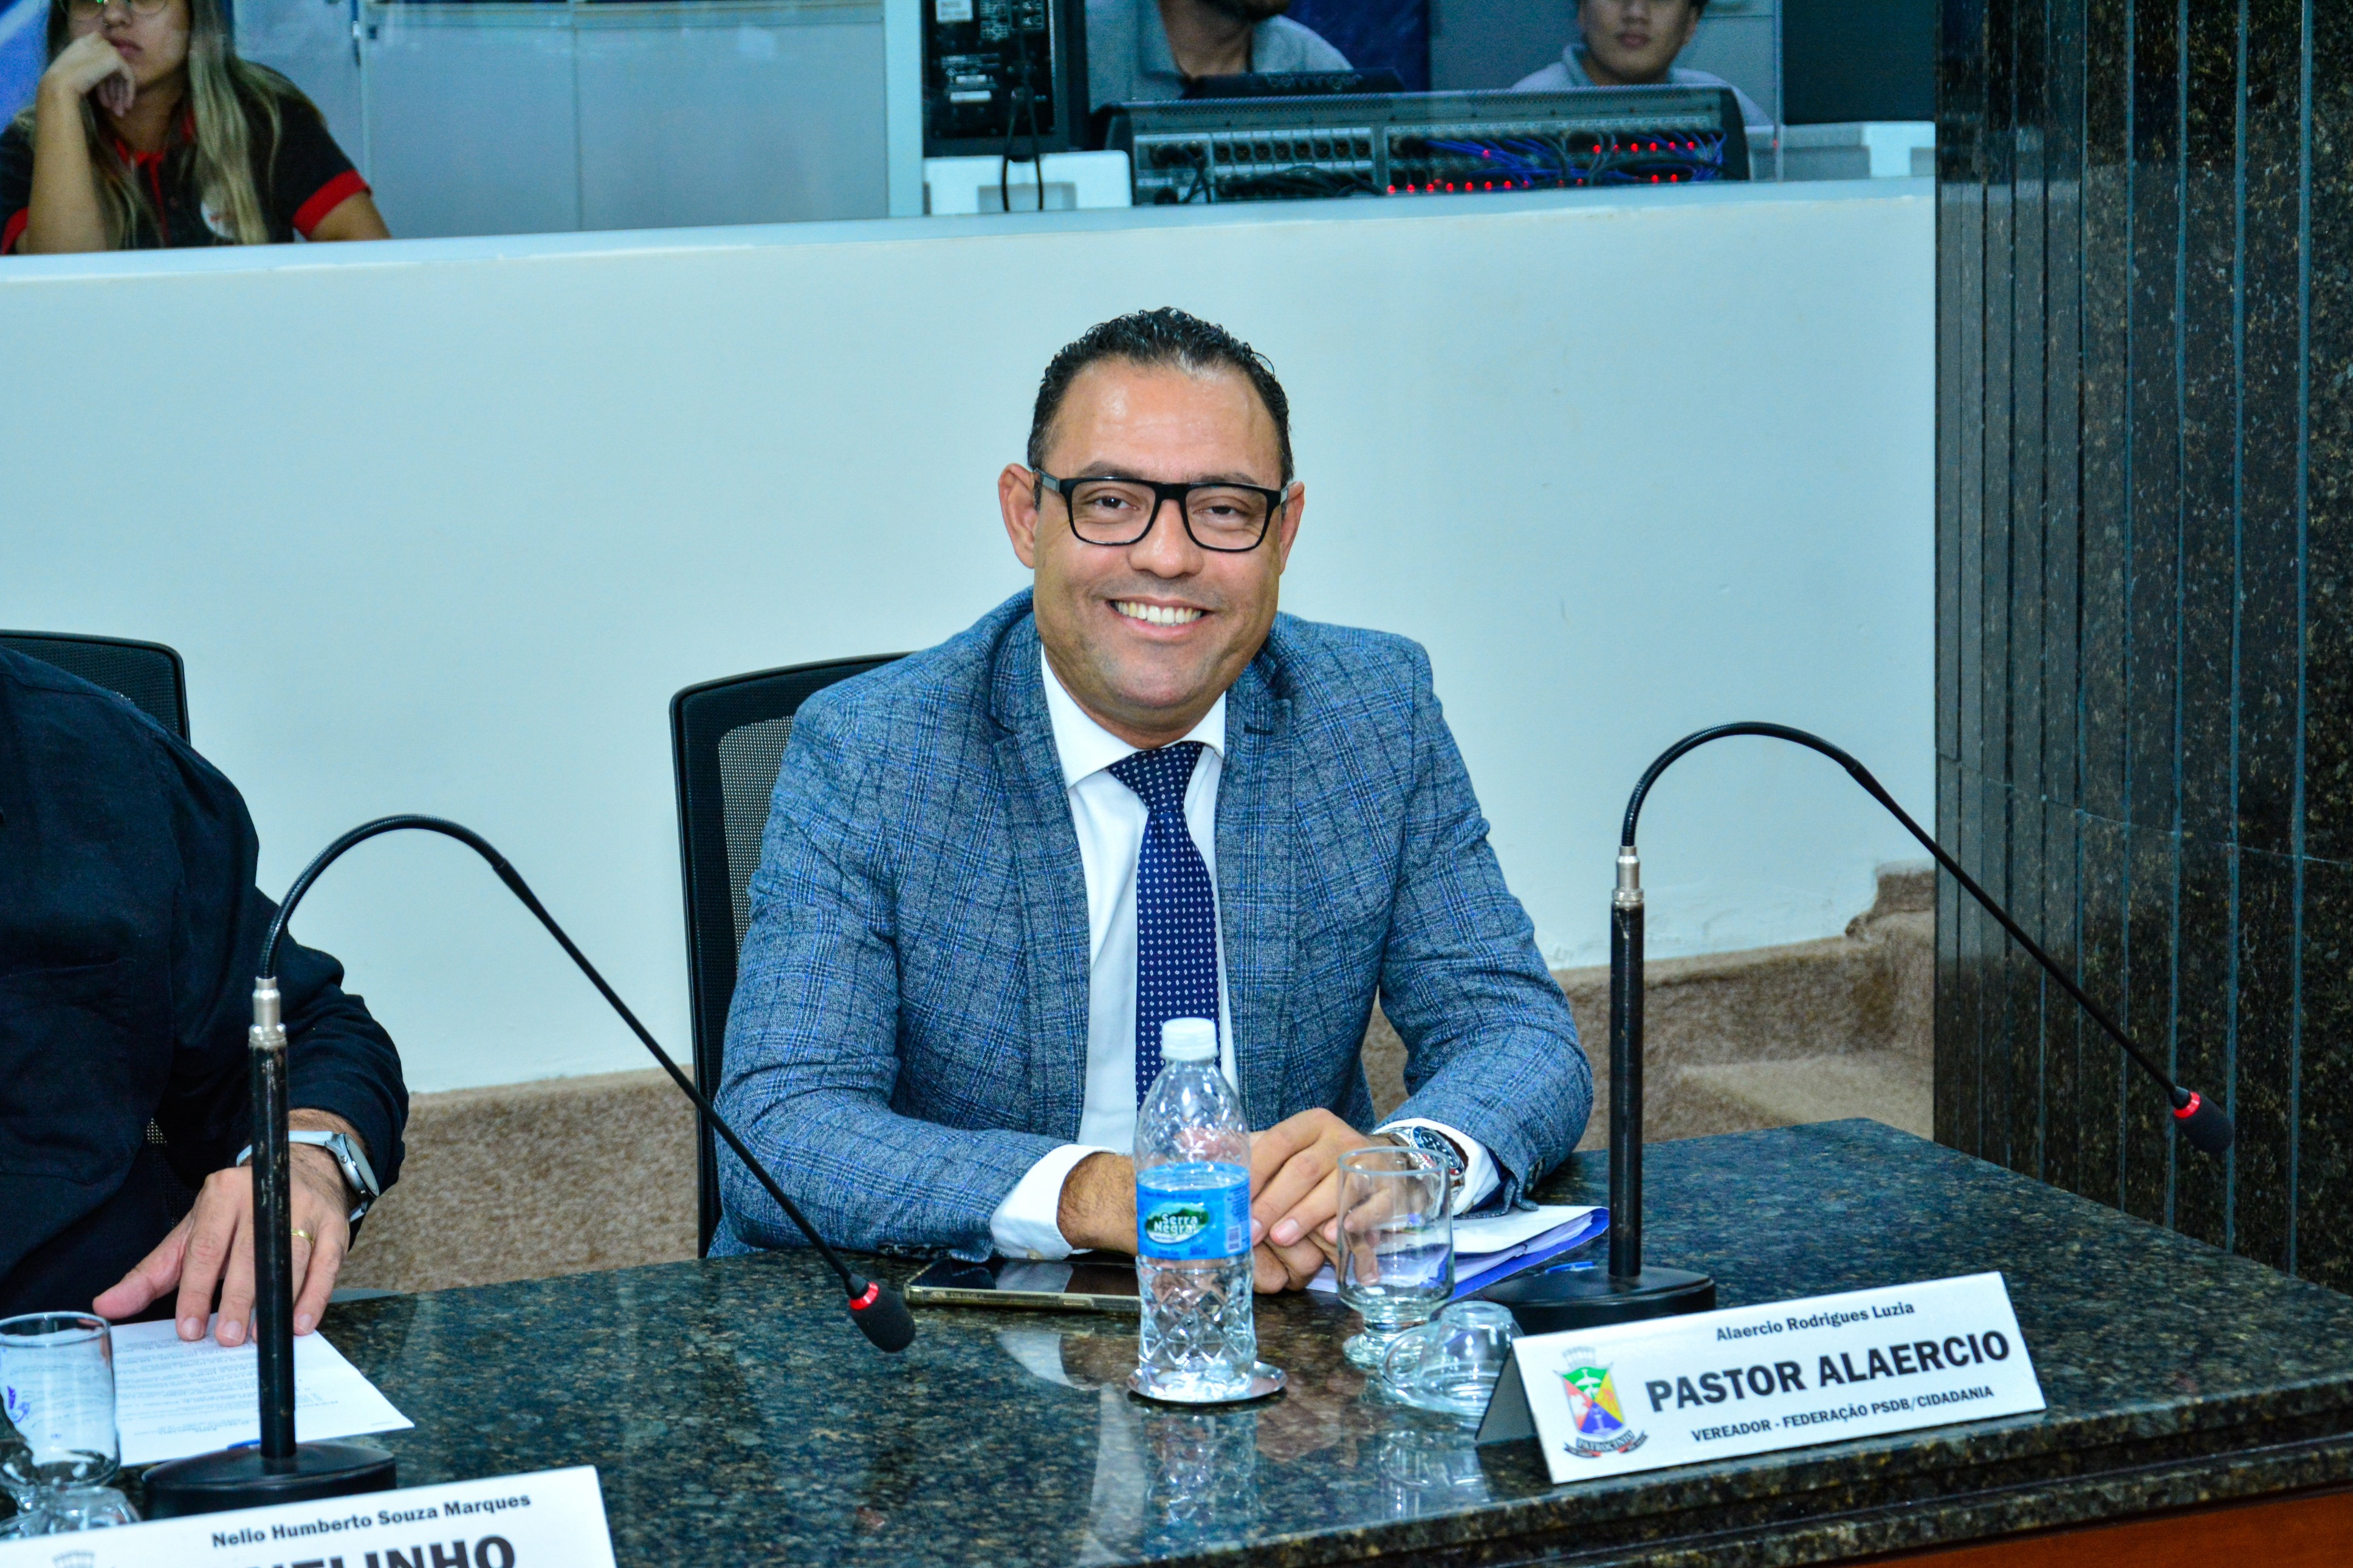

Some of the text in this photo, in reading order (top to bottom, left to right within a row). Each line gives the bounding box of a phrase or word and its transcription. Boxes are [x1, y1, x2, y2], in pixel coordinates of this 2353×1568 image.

[1153, 1221, 1195, 1236] Negra
[1161, 1213, 1198, 1225] Serra
[1716, 1301, 1915, 1341] Alaercio Rodrigues Luzia
[1644, 1330, 2011, 1412] PASTOR ALAERCIO
[1691, 1419, 1772, 1443] VEREADOR
[1781, 1402, 1869, 1429] FEDERAÇÃO
[1870, 1385, 1995, 1417] PSDB/CIDADANIA
[211, 1493, 531, 1548] Nelio Humberto Souza Marques
